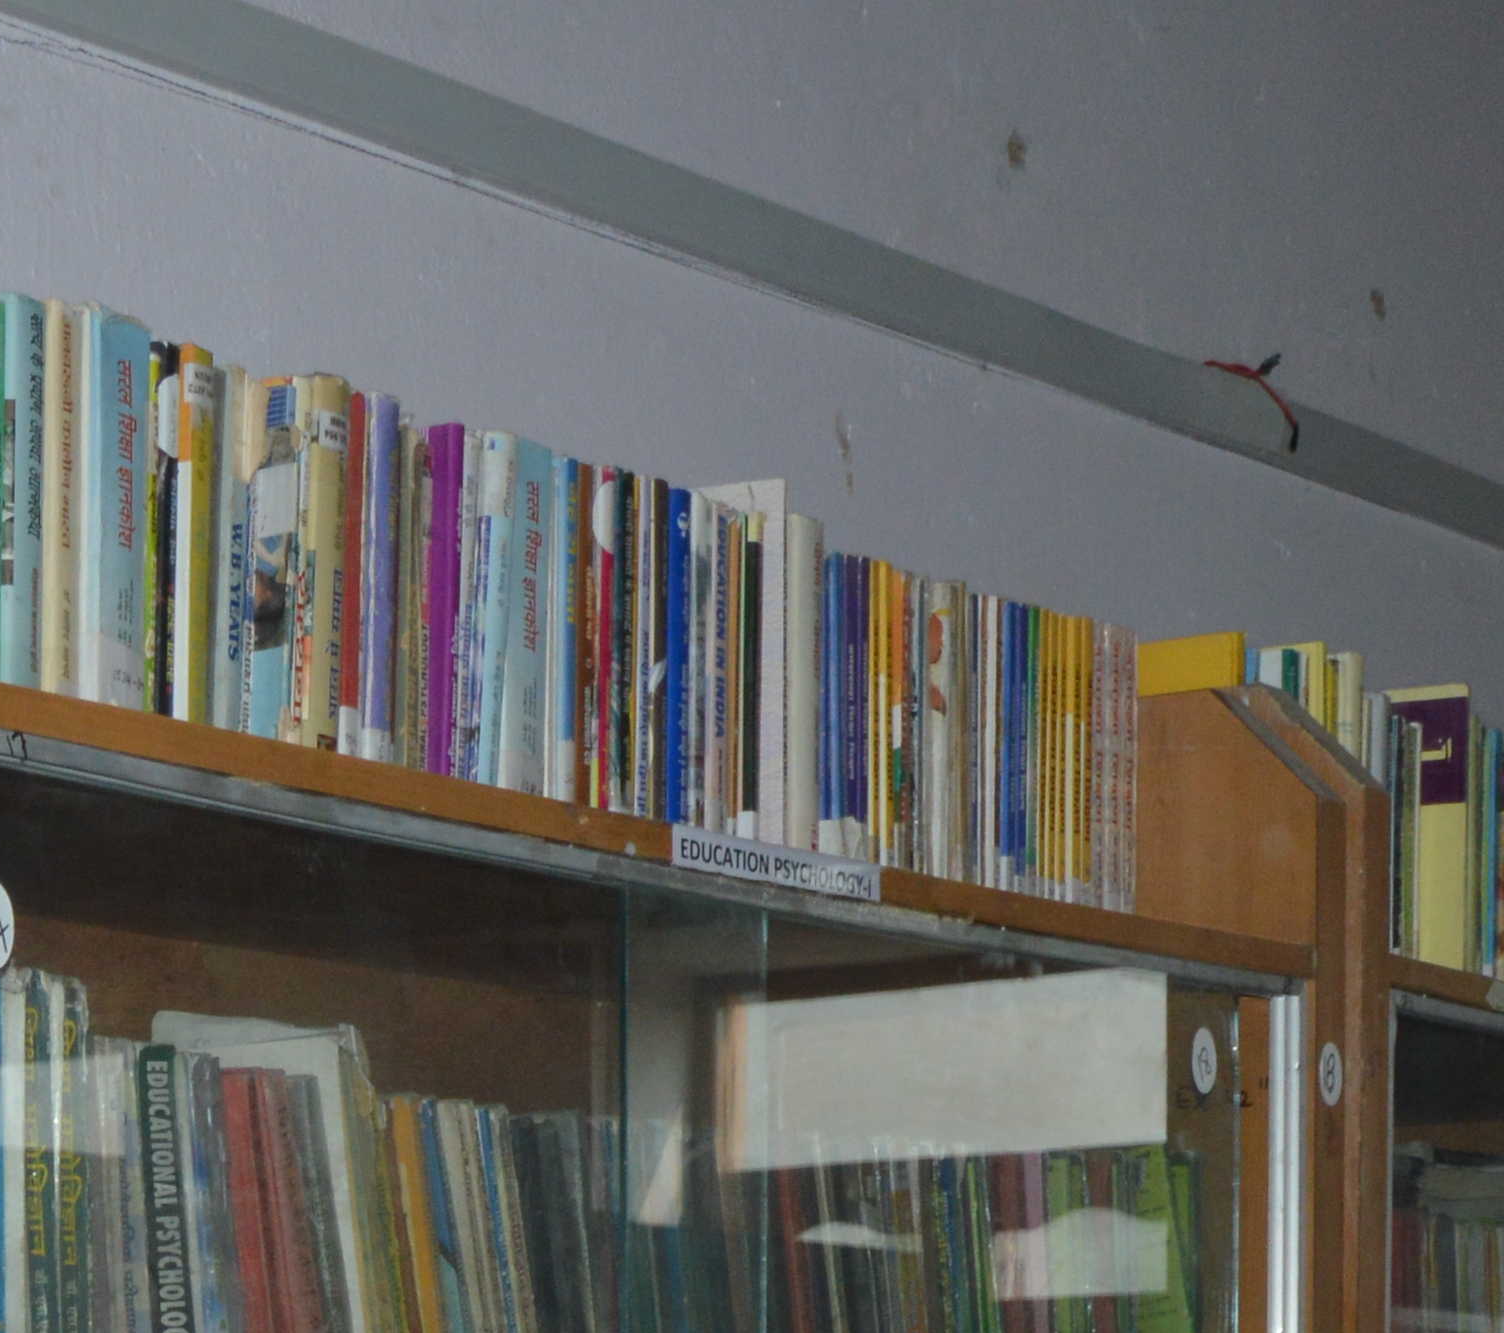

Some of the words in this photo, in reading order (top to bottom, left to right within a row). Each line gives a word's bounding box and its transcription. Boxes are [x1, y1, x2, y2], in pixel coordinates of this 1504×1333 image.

[716, 515, 727, 643] EDUCATION
[228, 583, 241, 661] YEATS
[714, 680, 726, 738] INDIA
[681, 838, 769, 875] EDUCATION
[146, 1060, 177, 1209] EDUCATIONAL
